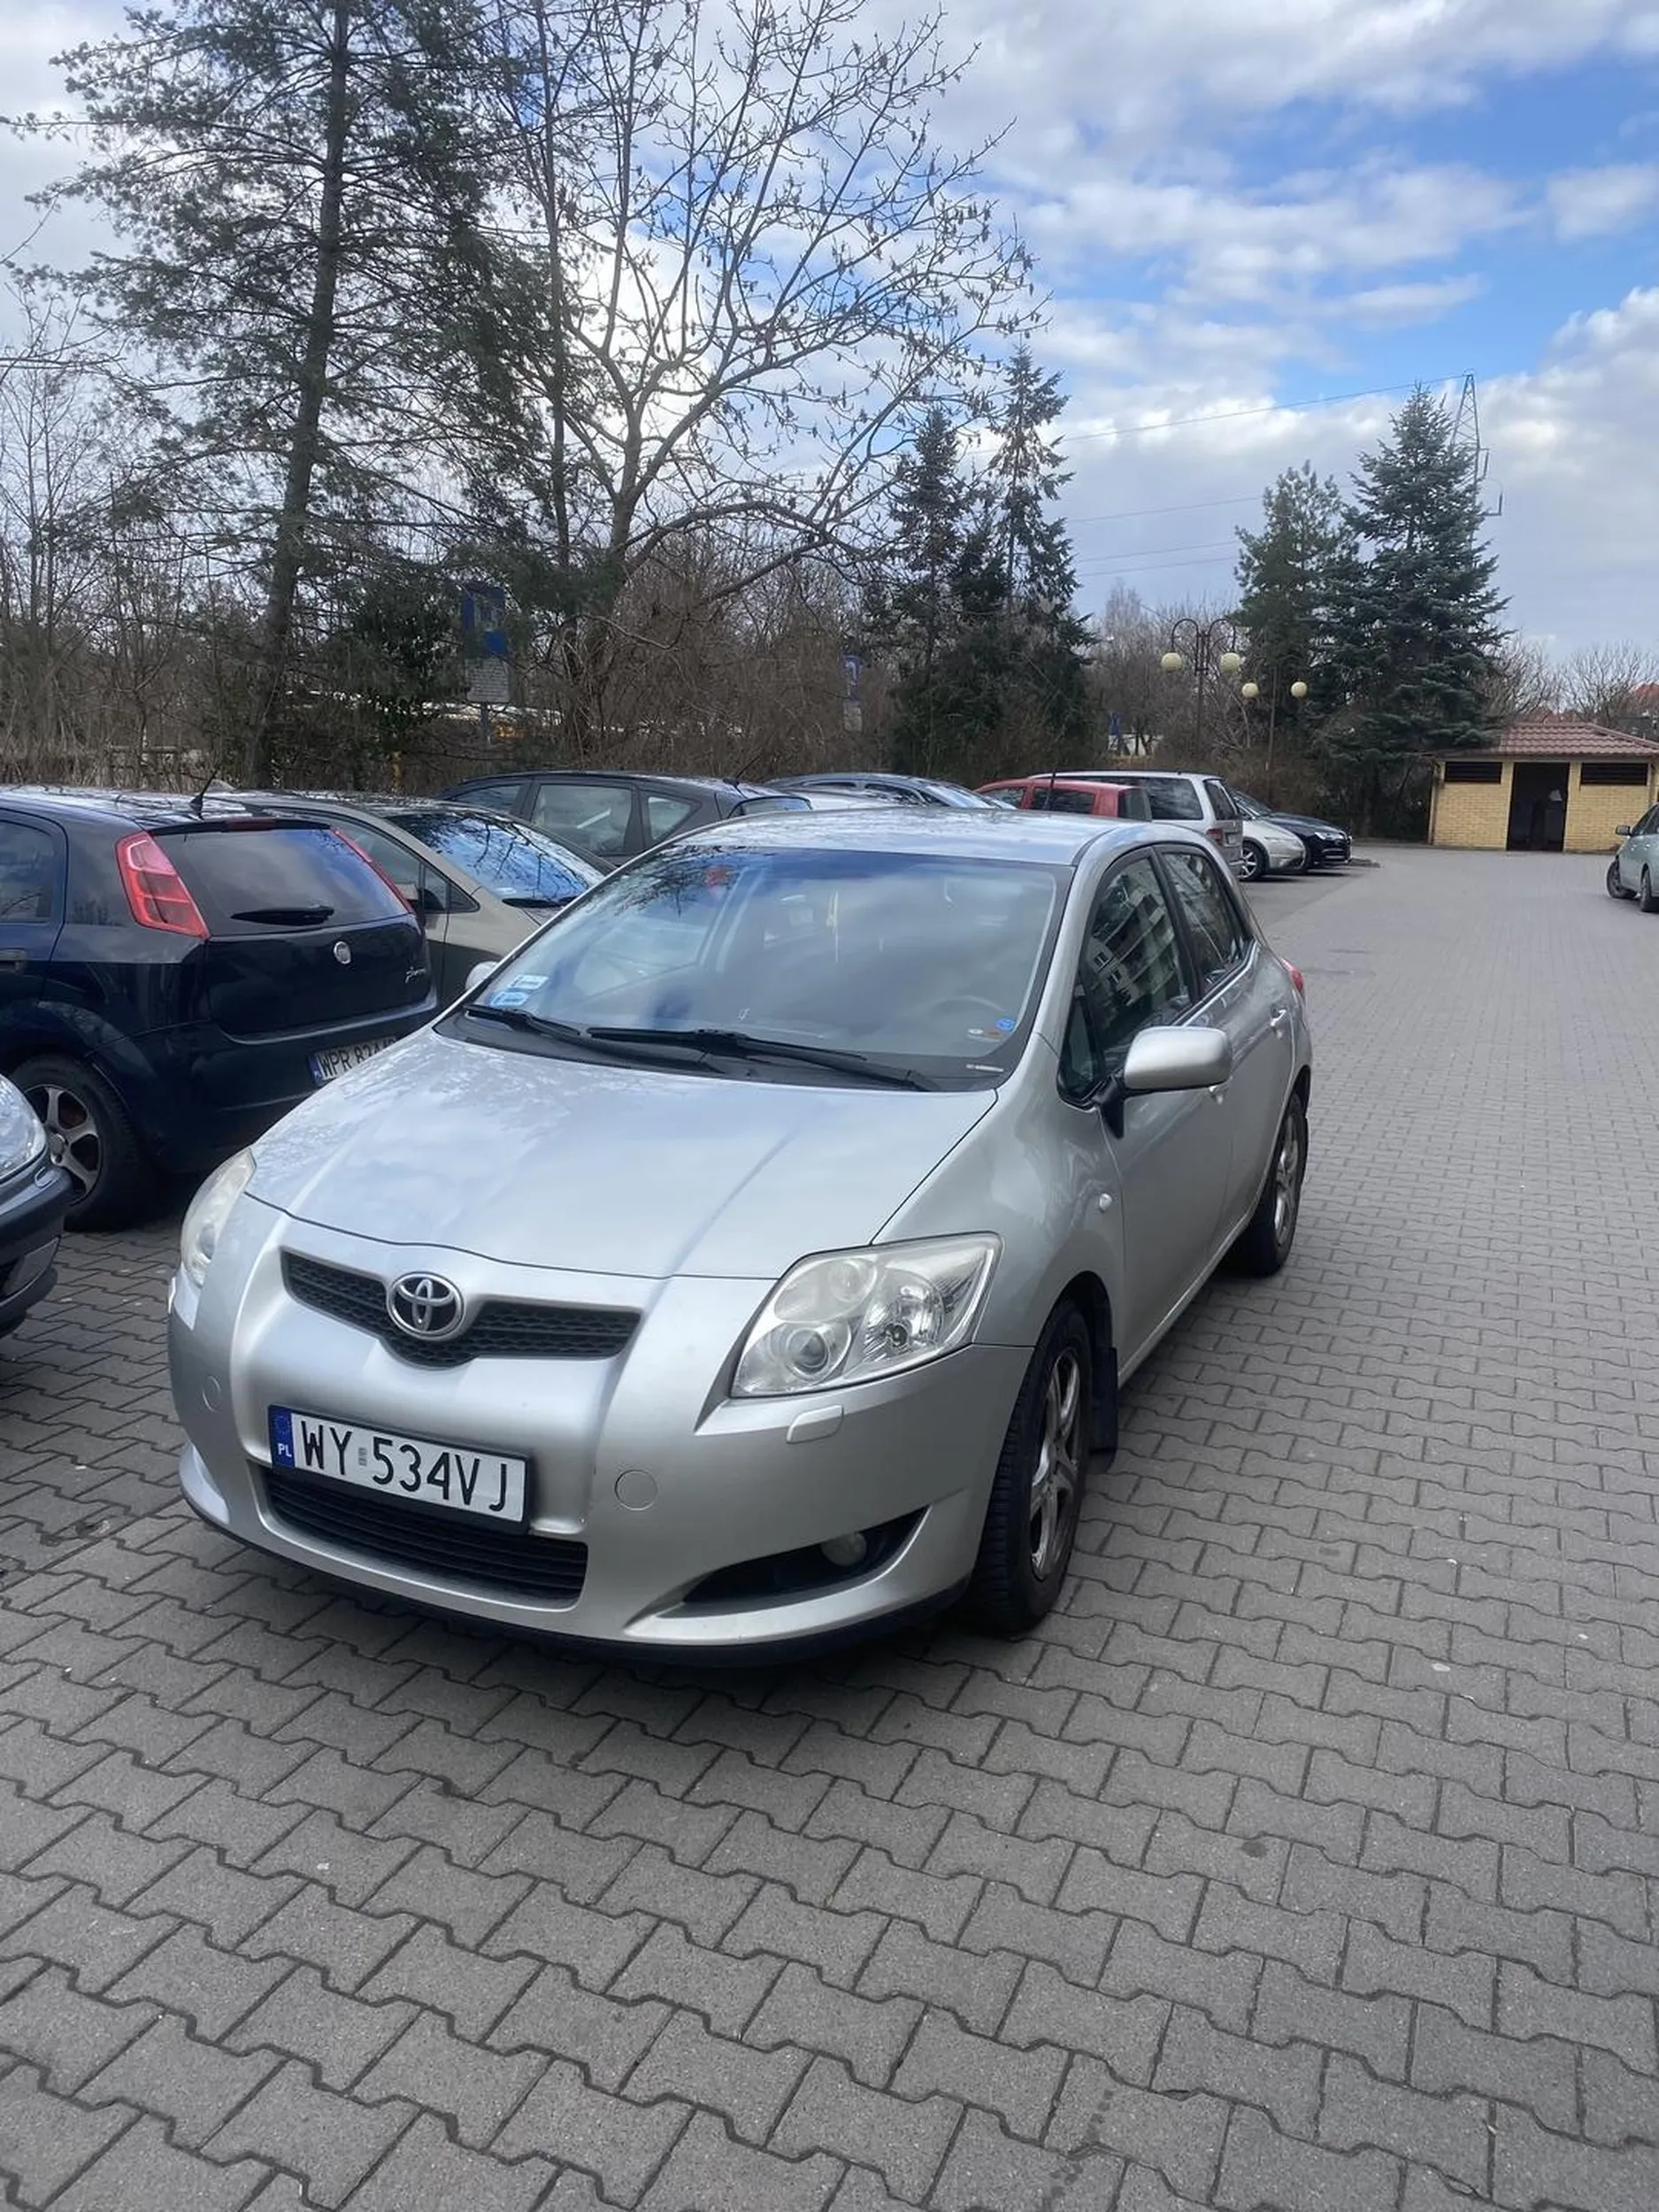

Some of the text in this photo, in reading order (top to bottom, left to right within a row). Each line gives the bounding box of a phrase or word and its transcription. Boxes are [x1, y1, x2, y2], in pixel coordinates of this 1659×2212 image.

[318, 1049, 352, 1077] WPR
[278, 1443, 292, 1457] PL
[301, 1420, 507, 1511] WY 534VJ
